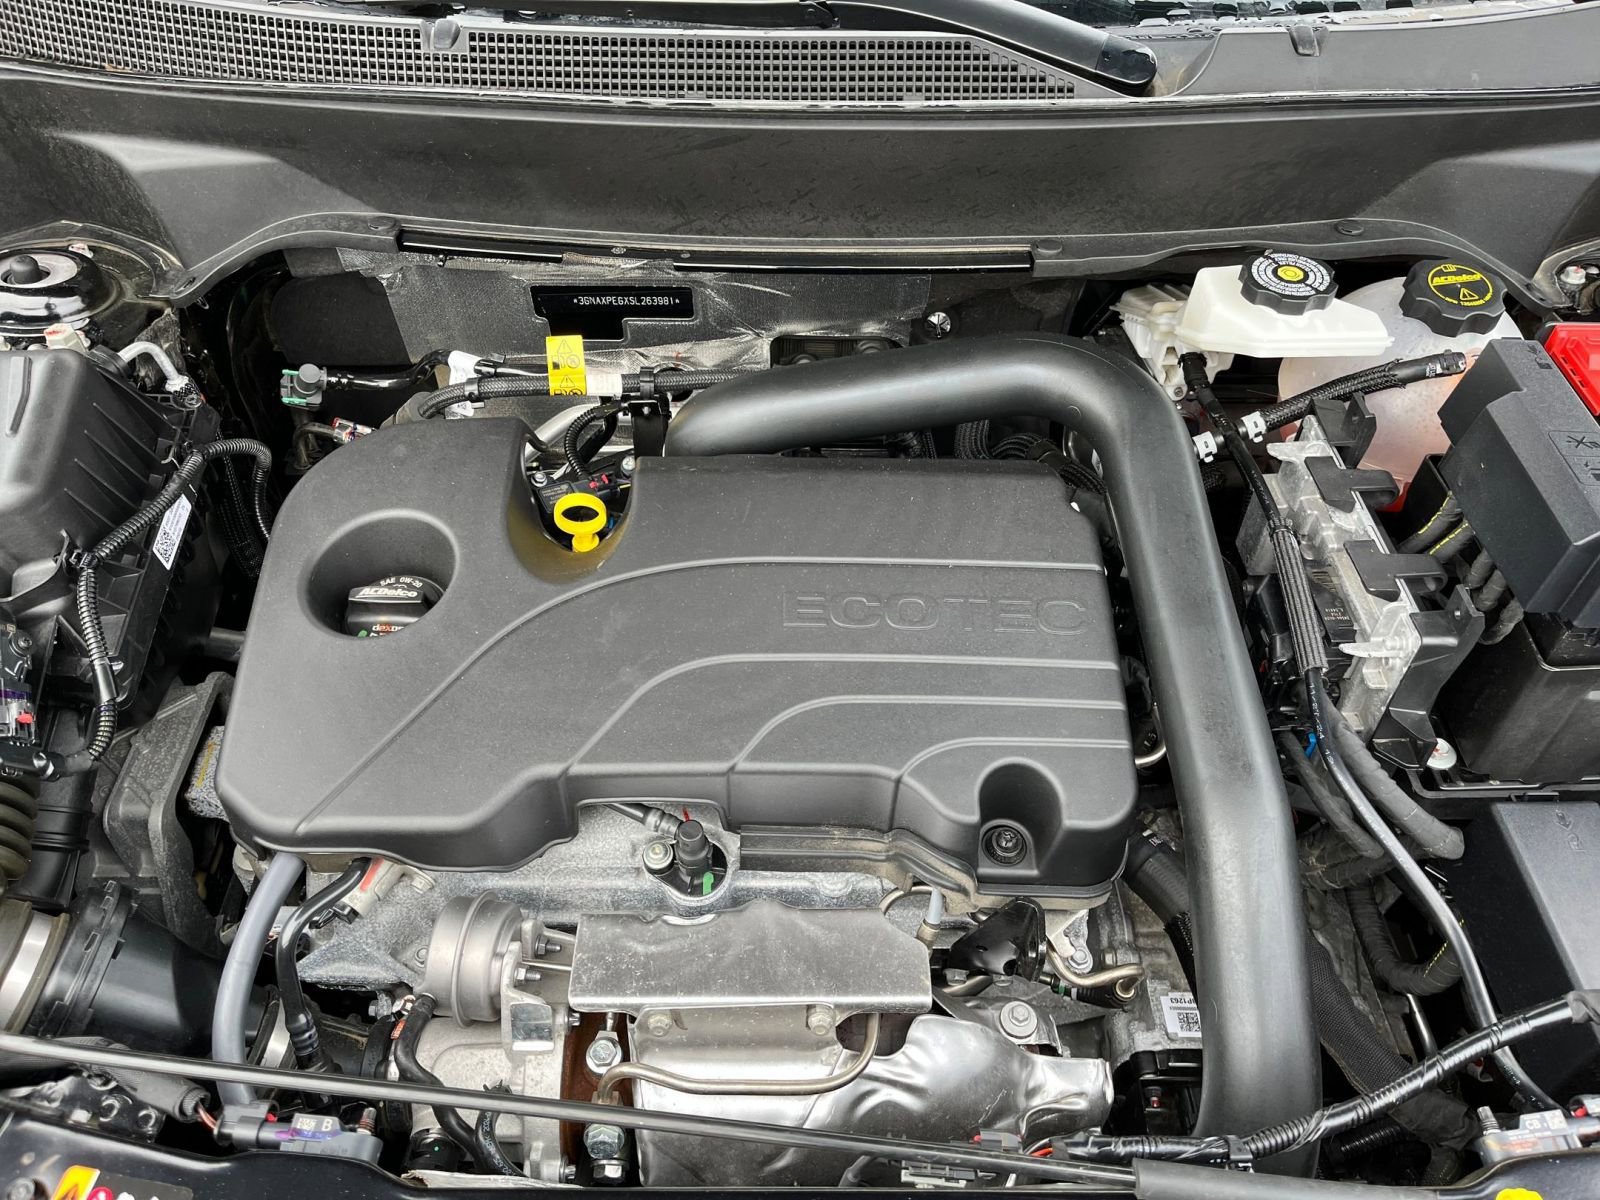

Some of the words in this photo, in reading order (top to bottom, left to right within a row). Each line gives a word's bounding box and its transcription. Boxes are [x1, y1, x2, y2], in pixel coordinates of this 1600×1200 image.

[380, 577, 396, 587] SAE
[399, 576, 423, 588] 0W-20
[357, 587, 418, 598] ACDelco
[782, 591, 1088, 636] ECOTEC
